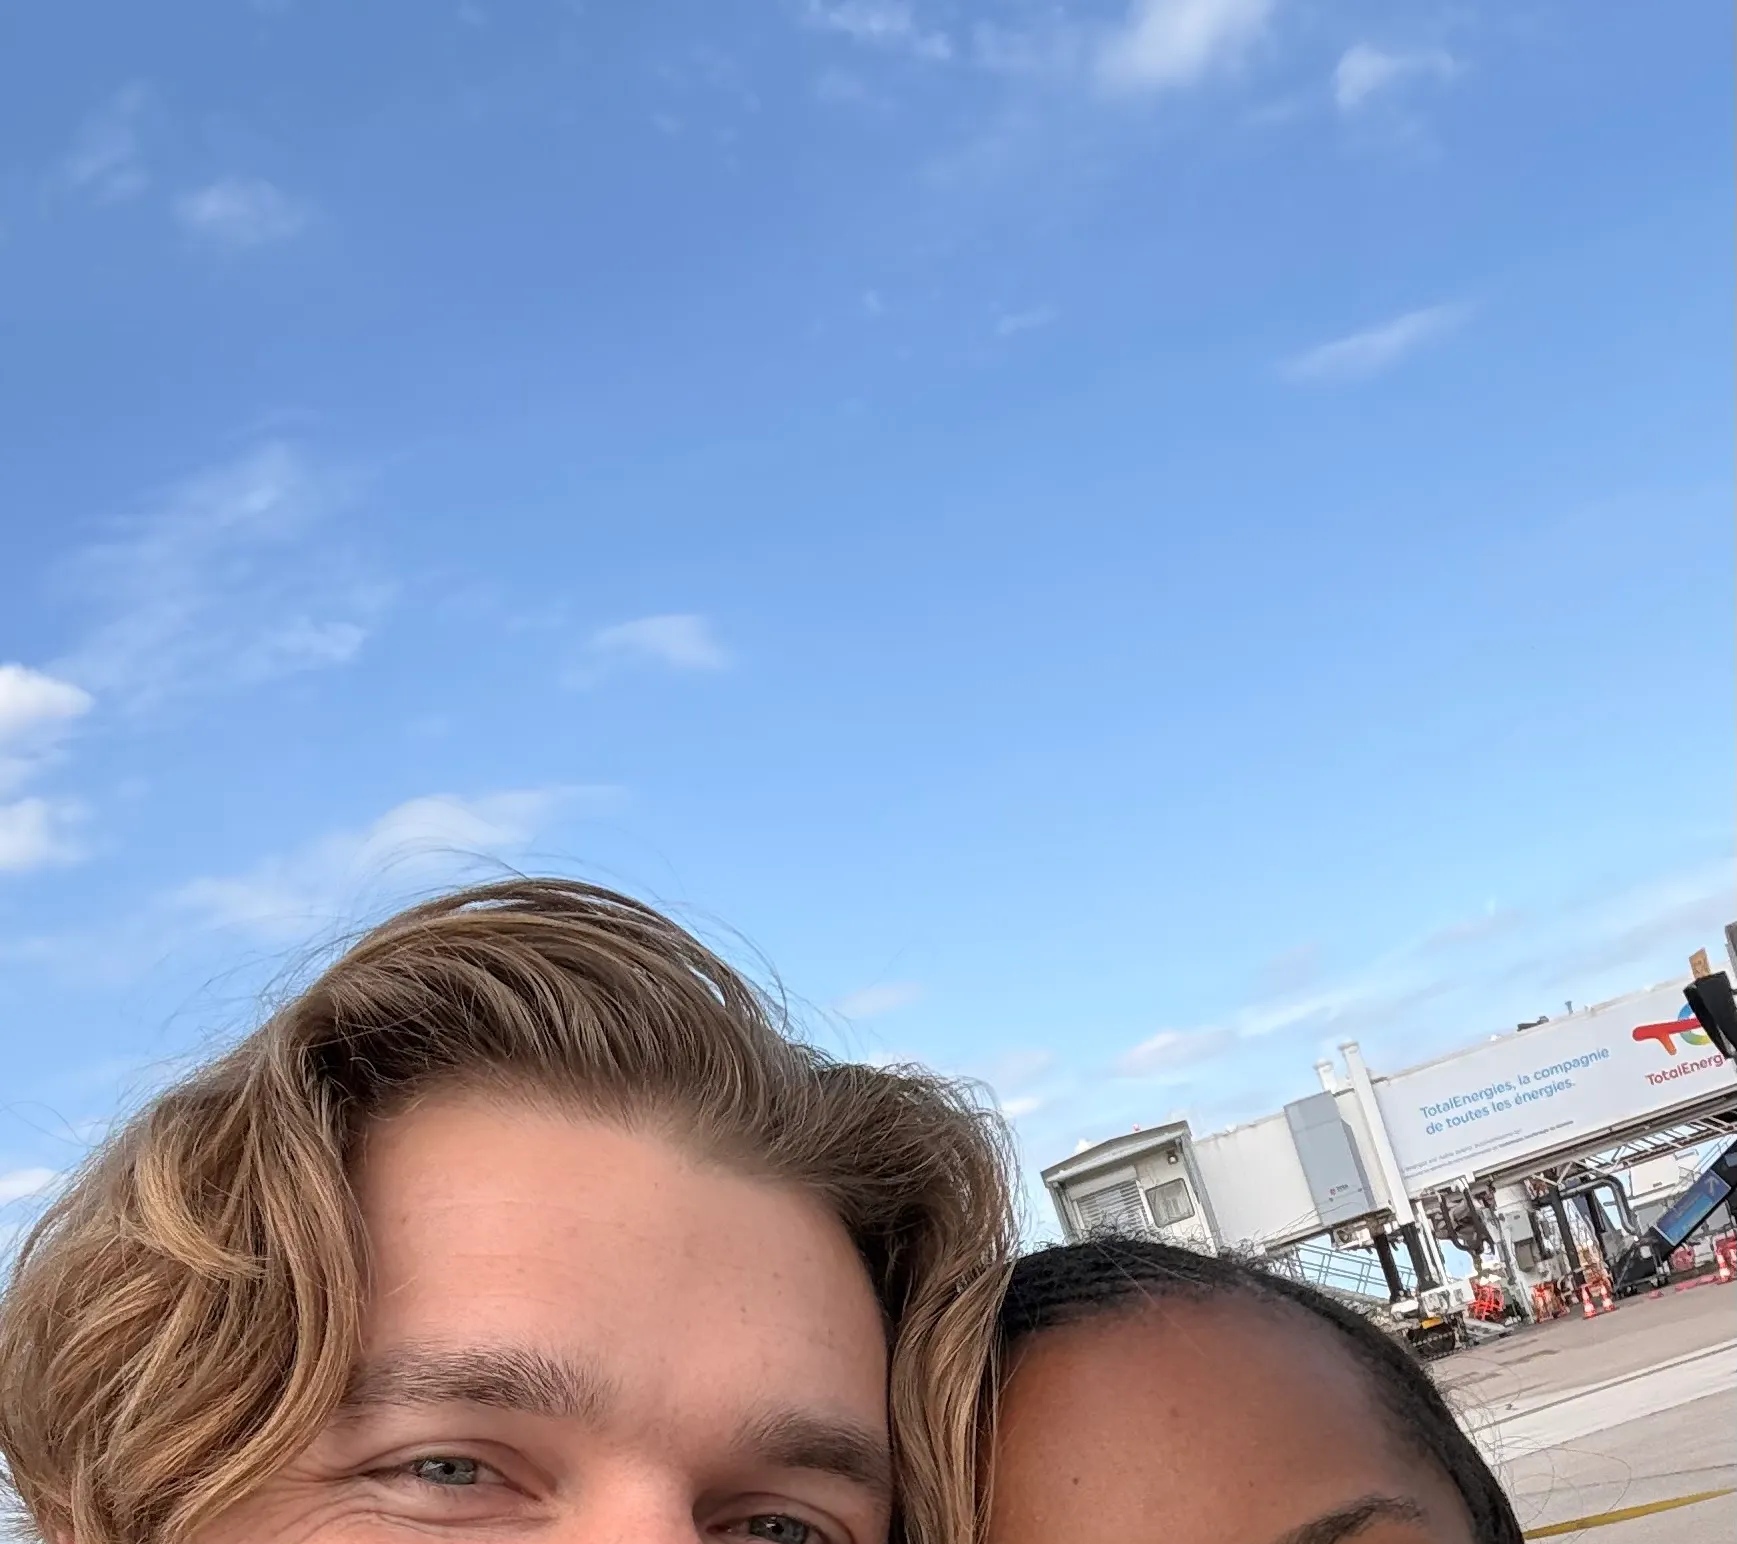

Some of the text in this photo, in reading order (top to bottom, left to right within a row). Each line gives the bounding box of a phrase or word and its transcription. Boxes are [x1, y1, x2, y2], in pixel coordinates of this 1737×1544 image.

[1420, 1048, 1610, 1119] TotalEnergies, la compagnie
[1425, 1078, 1576, 1135] de toutes les énergies.
